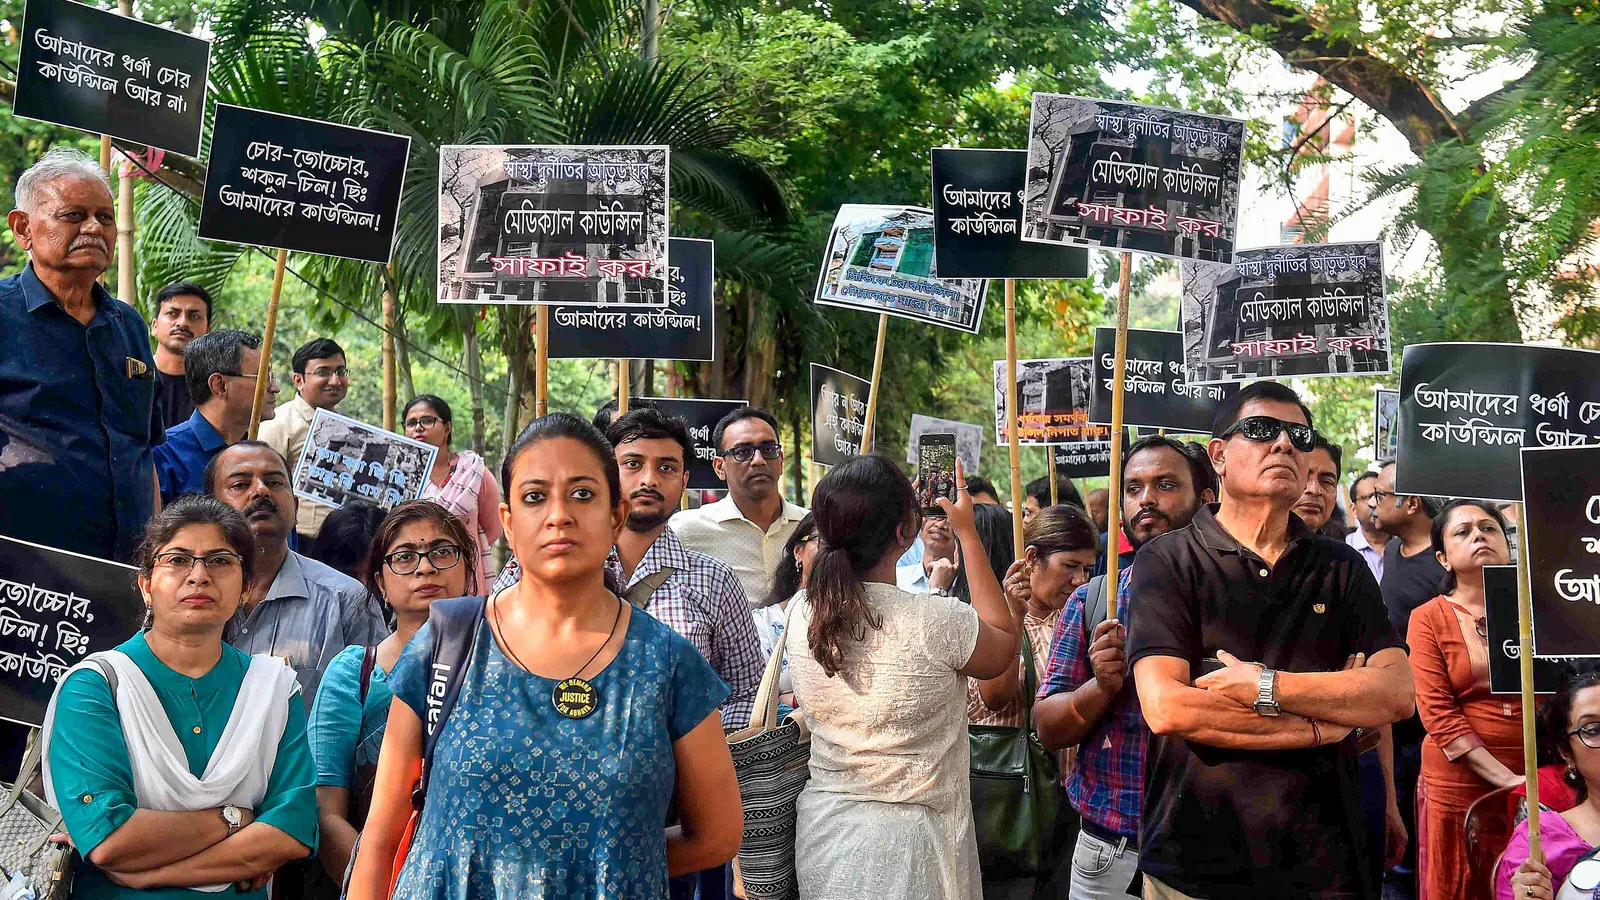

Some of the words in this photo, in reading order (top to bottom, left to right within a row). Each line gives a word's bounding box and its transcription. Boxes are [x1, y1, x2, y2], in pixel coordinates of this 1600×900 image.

[34, 28, 115, 67] আমাদের
[121, 54, 151, 79] ধর্ণা
[157, 66, 192, 89] চোর
[36, 60, 118, 94] কাউন্সিল
[124, 78, 162, 106] আর
[1094, 112, 1125, 134] স্বাস্থ্য
[1127, 113, 1171, 140] দুর্নীতির
[1211, 129, 1229, 148] ঘর
[240, 166, 337, 199] শকুন-চিল!
[343, 177, 368, 203] ছিঃ
[503, 161, 533, 180] স্বাস্থ্য
[537, 155, 585, 185] দুর্নীতির
[630, 162, 650, 180] ঘর
[1092, 150, 1159, 189] মেডিক্যাল
[1162, 161, 1221, 199] কাউন্সিল
[219, 185, 296, 217] আমাদের
[300, 201, 381, 231] কাউন্সিল!
[943, 184, 1011, 210] আমাদের
[504, 198, 575, 236] মেডিক্যাল
[579, 200, 644, 236] কাউন্সিল
[948, 211, 1017, 236] কাউন্সিল
[1077, 202, 1168, 231] সাফাই
[1176, 215, 1223, 238] কর
[491, 251, 588, 278] সাফাই
[597, 259, 650, 279] কর
[1235, 259, 1262, 277] স্বাস্থ্য
[1265, 253, 1307, 279] দুর্নীতির
[1349, 254, 1367, 271] ঘর
[554, 307, 627, 330] আমাদের
[630, 308, 701, 331] কাউন্সিল!
[1240, 291, 1302, 323] মেডিক্যাল
[1305, 287, 1365, 318] কাউন্সিল
[1231, 333, 1319, 356] সাফাই
[1326, 335, 1373, 351] কর
[1103, 375, 1166, 394] কউন্সিল
[1172, 379, 1203, 398] আর
[1414, 383, 1519, 416] আমাদের
[1529, 391, 1570, 420] ধর্ণা
[834, 434, 851, 456] আর
[1418, 416, 1527, 447] কাউন্সিল
[55, 620, 90, 656] ছিঃ
[559, 691, 591, 704] JUSTICE
[568, 679, 593, 692] DEMAND
